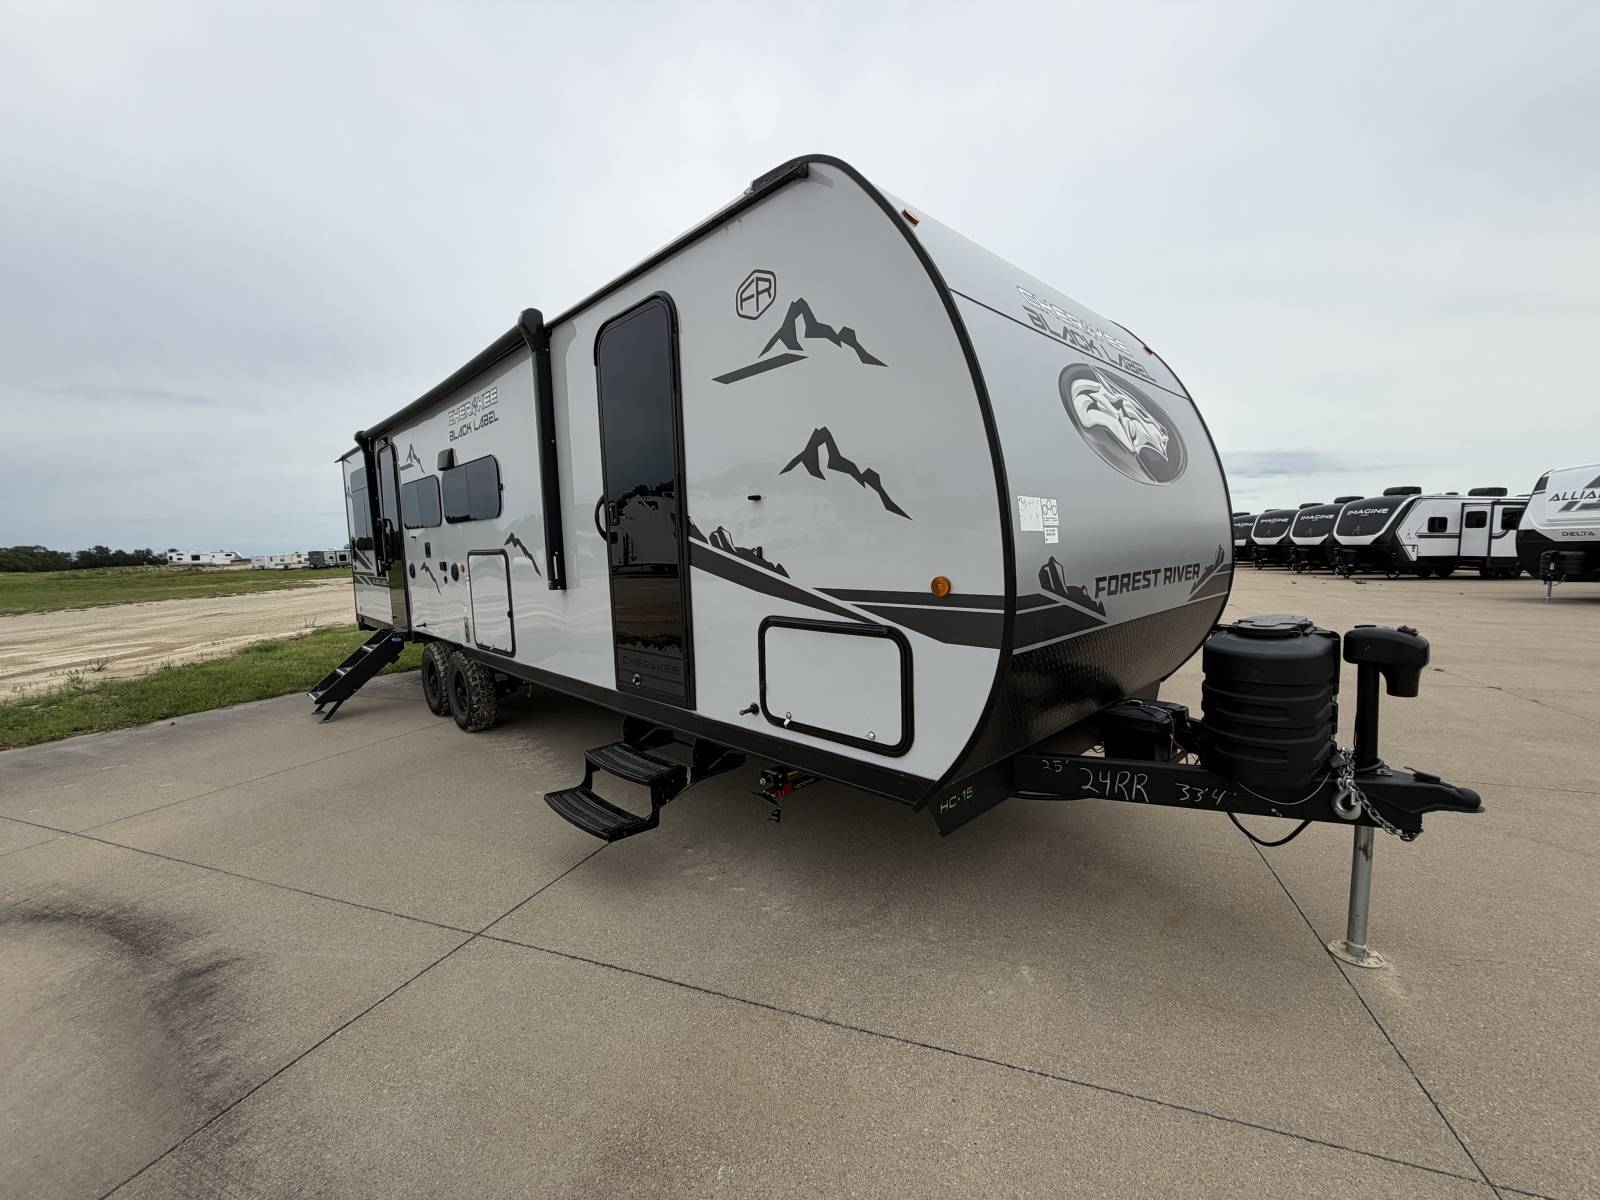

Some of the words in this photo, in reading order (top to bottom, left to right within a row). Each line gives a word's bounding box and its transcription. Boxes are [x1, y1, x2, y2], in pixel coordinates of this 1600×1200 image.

[1022, 304, 1103, 359] BLACK
[1100, 344, 1157, 383] LABEL
[449, 421, 472, 441] BLACK
[473, 410, 499, 431] LABEL
[1346, 507, 1390, 516] IMAGINE
[1549, 490, 1600, 502] ALLIA
[1095, 568, 1161, 599] FOREST
[1163, 563, 1201, 585] RIVER
[1079, 768, 1149, 803] 24RR
